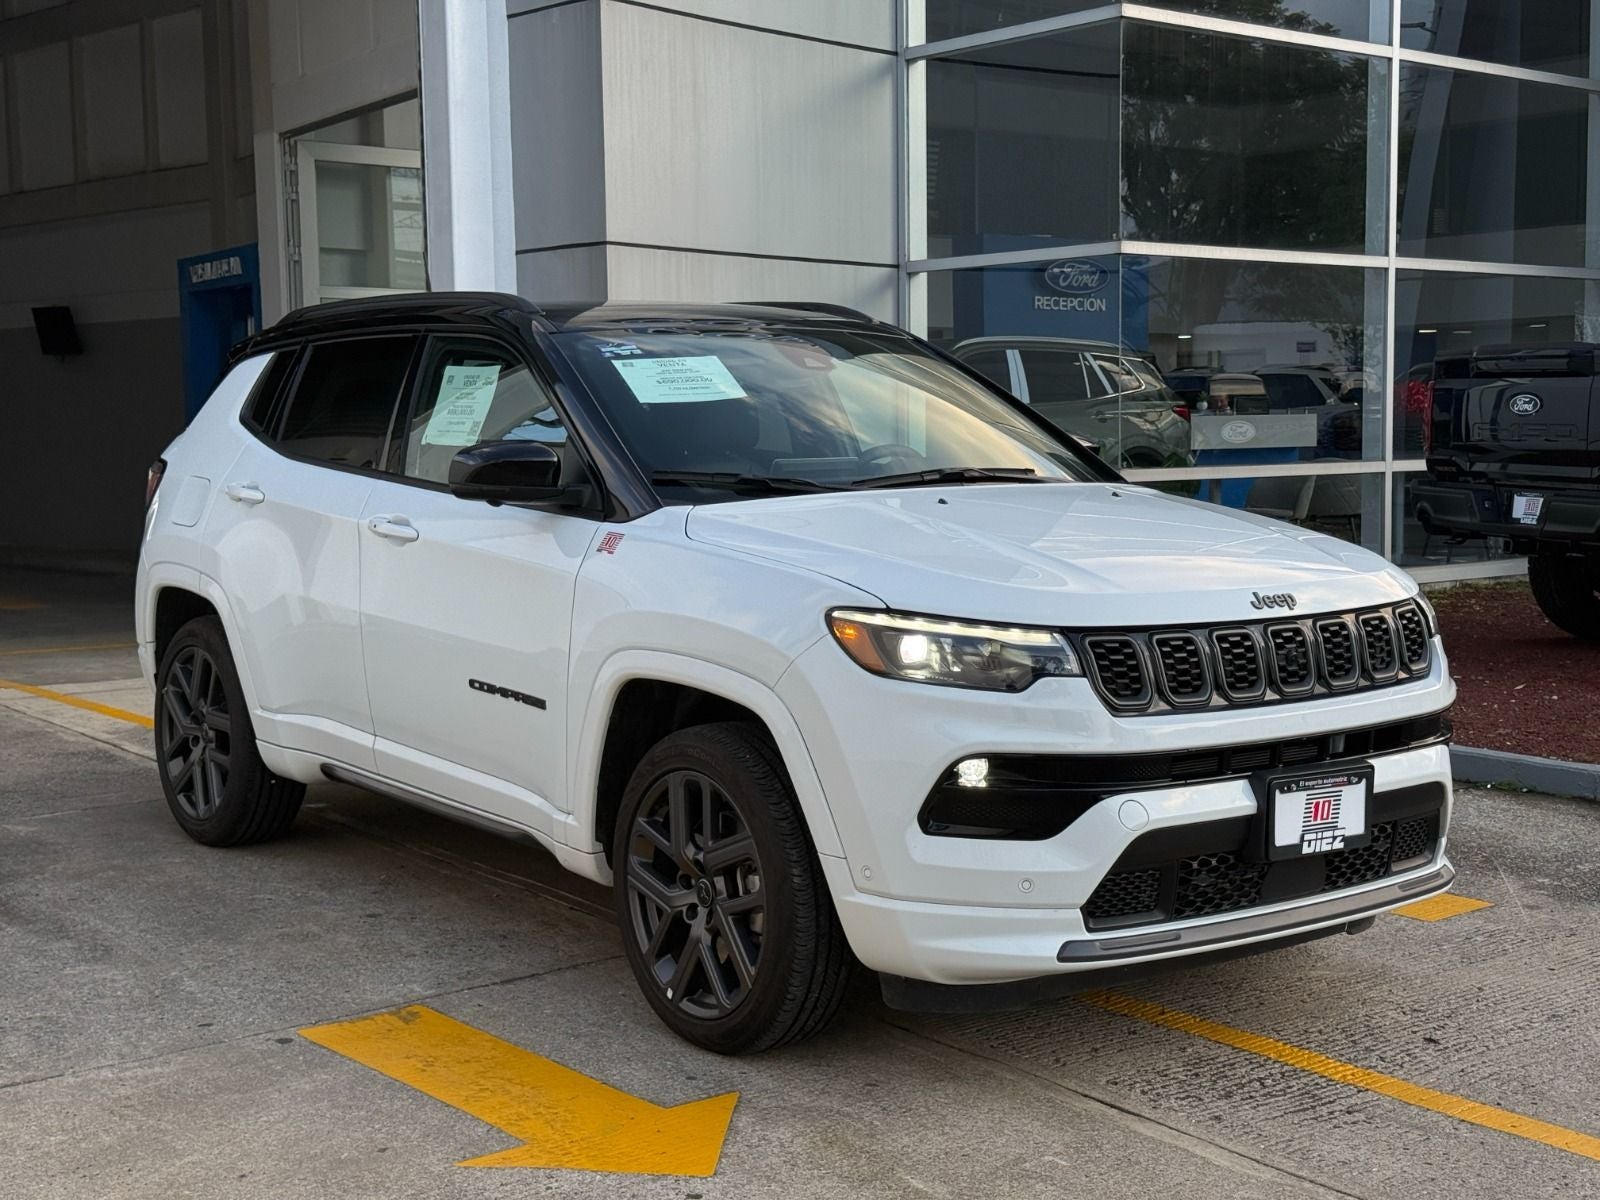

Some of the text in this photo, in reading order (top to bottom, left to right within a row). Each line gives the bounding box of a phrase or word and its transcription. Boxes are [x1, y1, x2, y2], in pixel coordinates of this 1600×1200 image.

[1059, 262, 1100, 287] Ford
[1034, 294, 1106, 311] RECEPCIÓN
[1250, 591, 1297, 611] Jeep
[1312, 799, 1332, 822] 10
